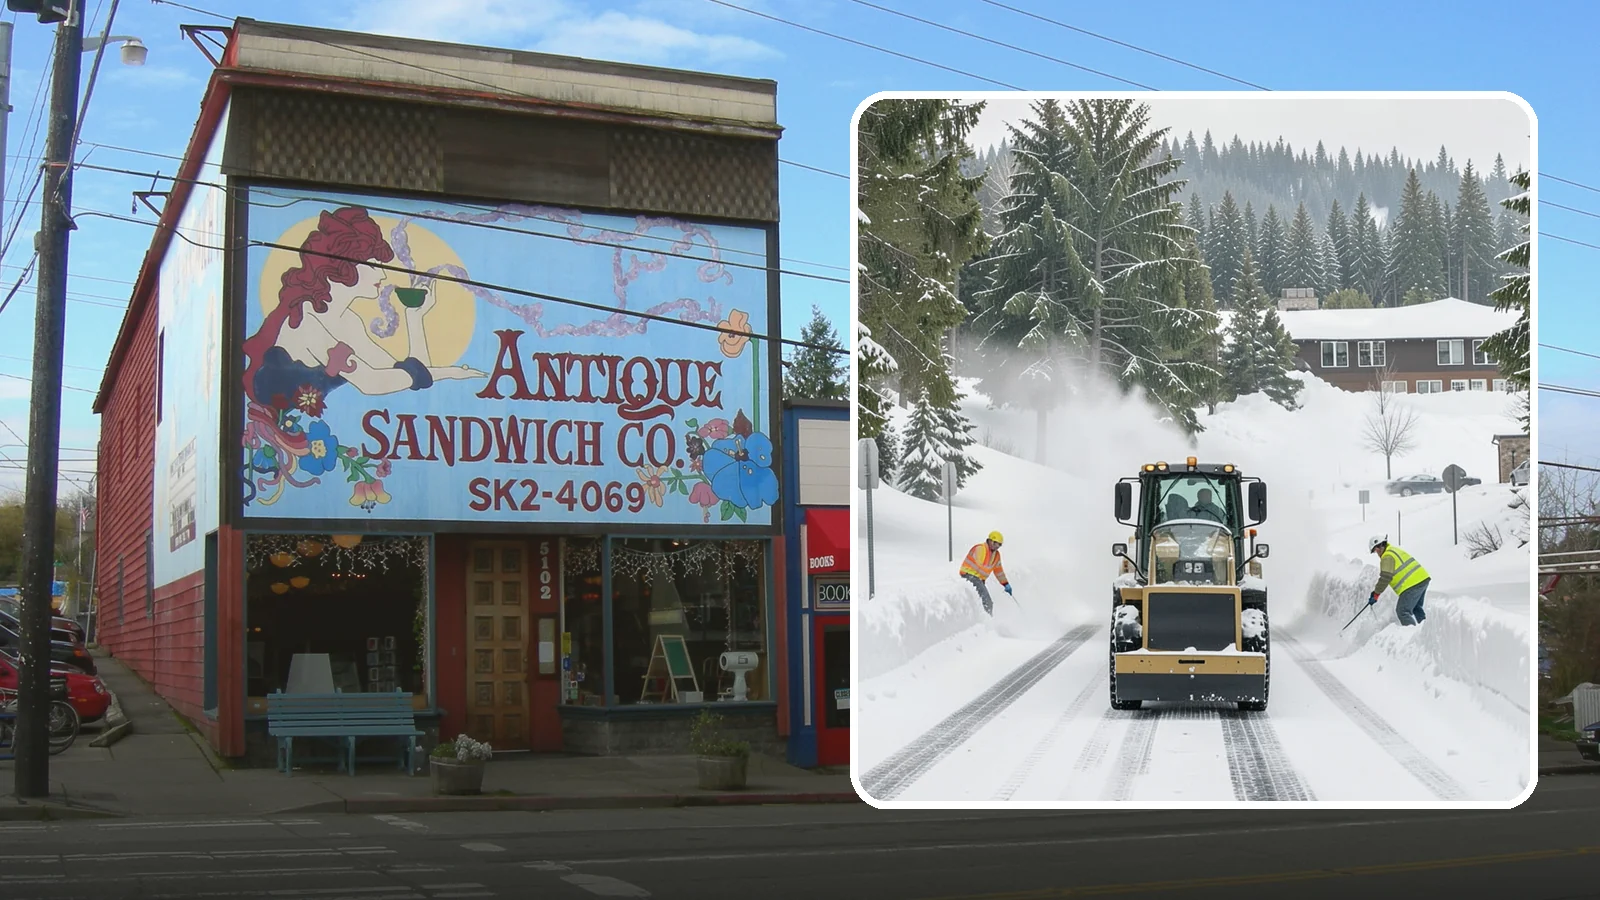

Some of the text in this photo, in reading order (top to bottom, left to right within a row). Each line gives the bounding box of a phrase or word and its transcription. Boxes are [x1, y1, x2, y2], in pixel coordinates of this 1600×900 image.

[476, 329, 724, 420] ANTIQUE
[361, 408, 685, 468] SANDWICH CO.
[468, 477, 646, 512] SK2-4069
[540, 542, 552, 599] 5102
[809, 555, 835, 569] BOOKS
